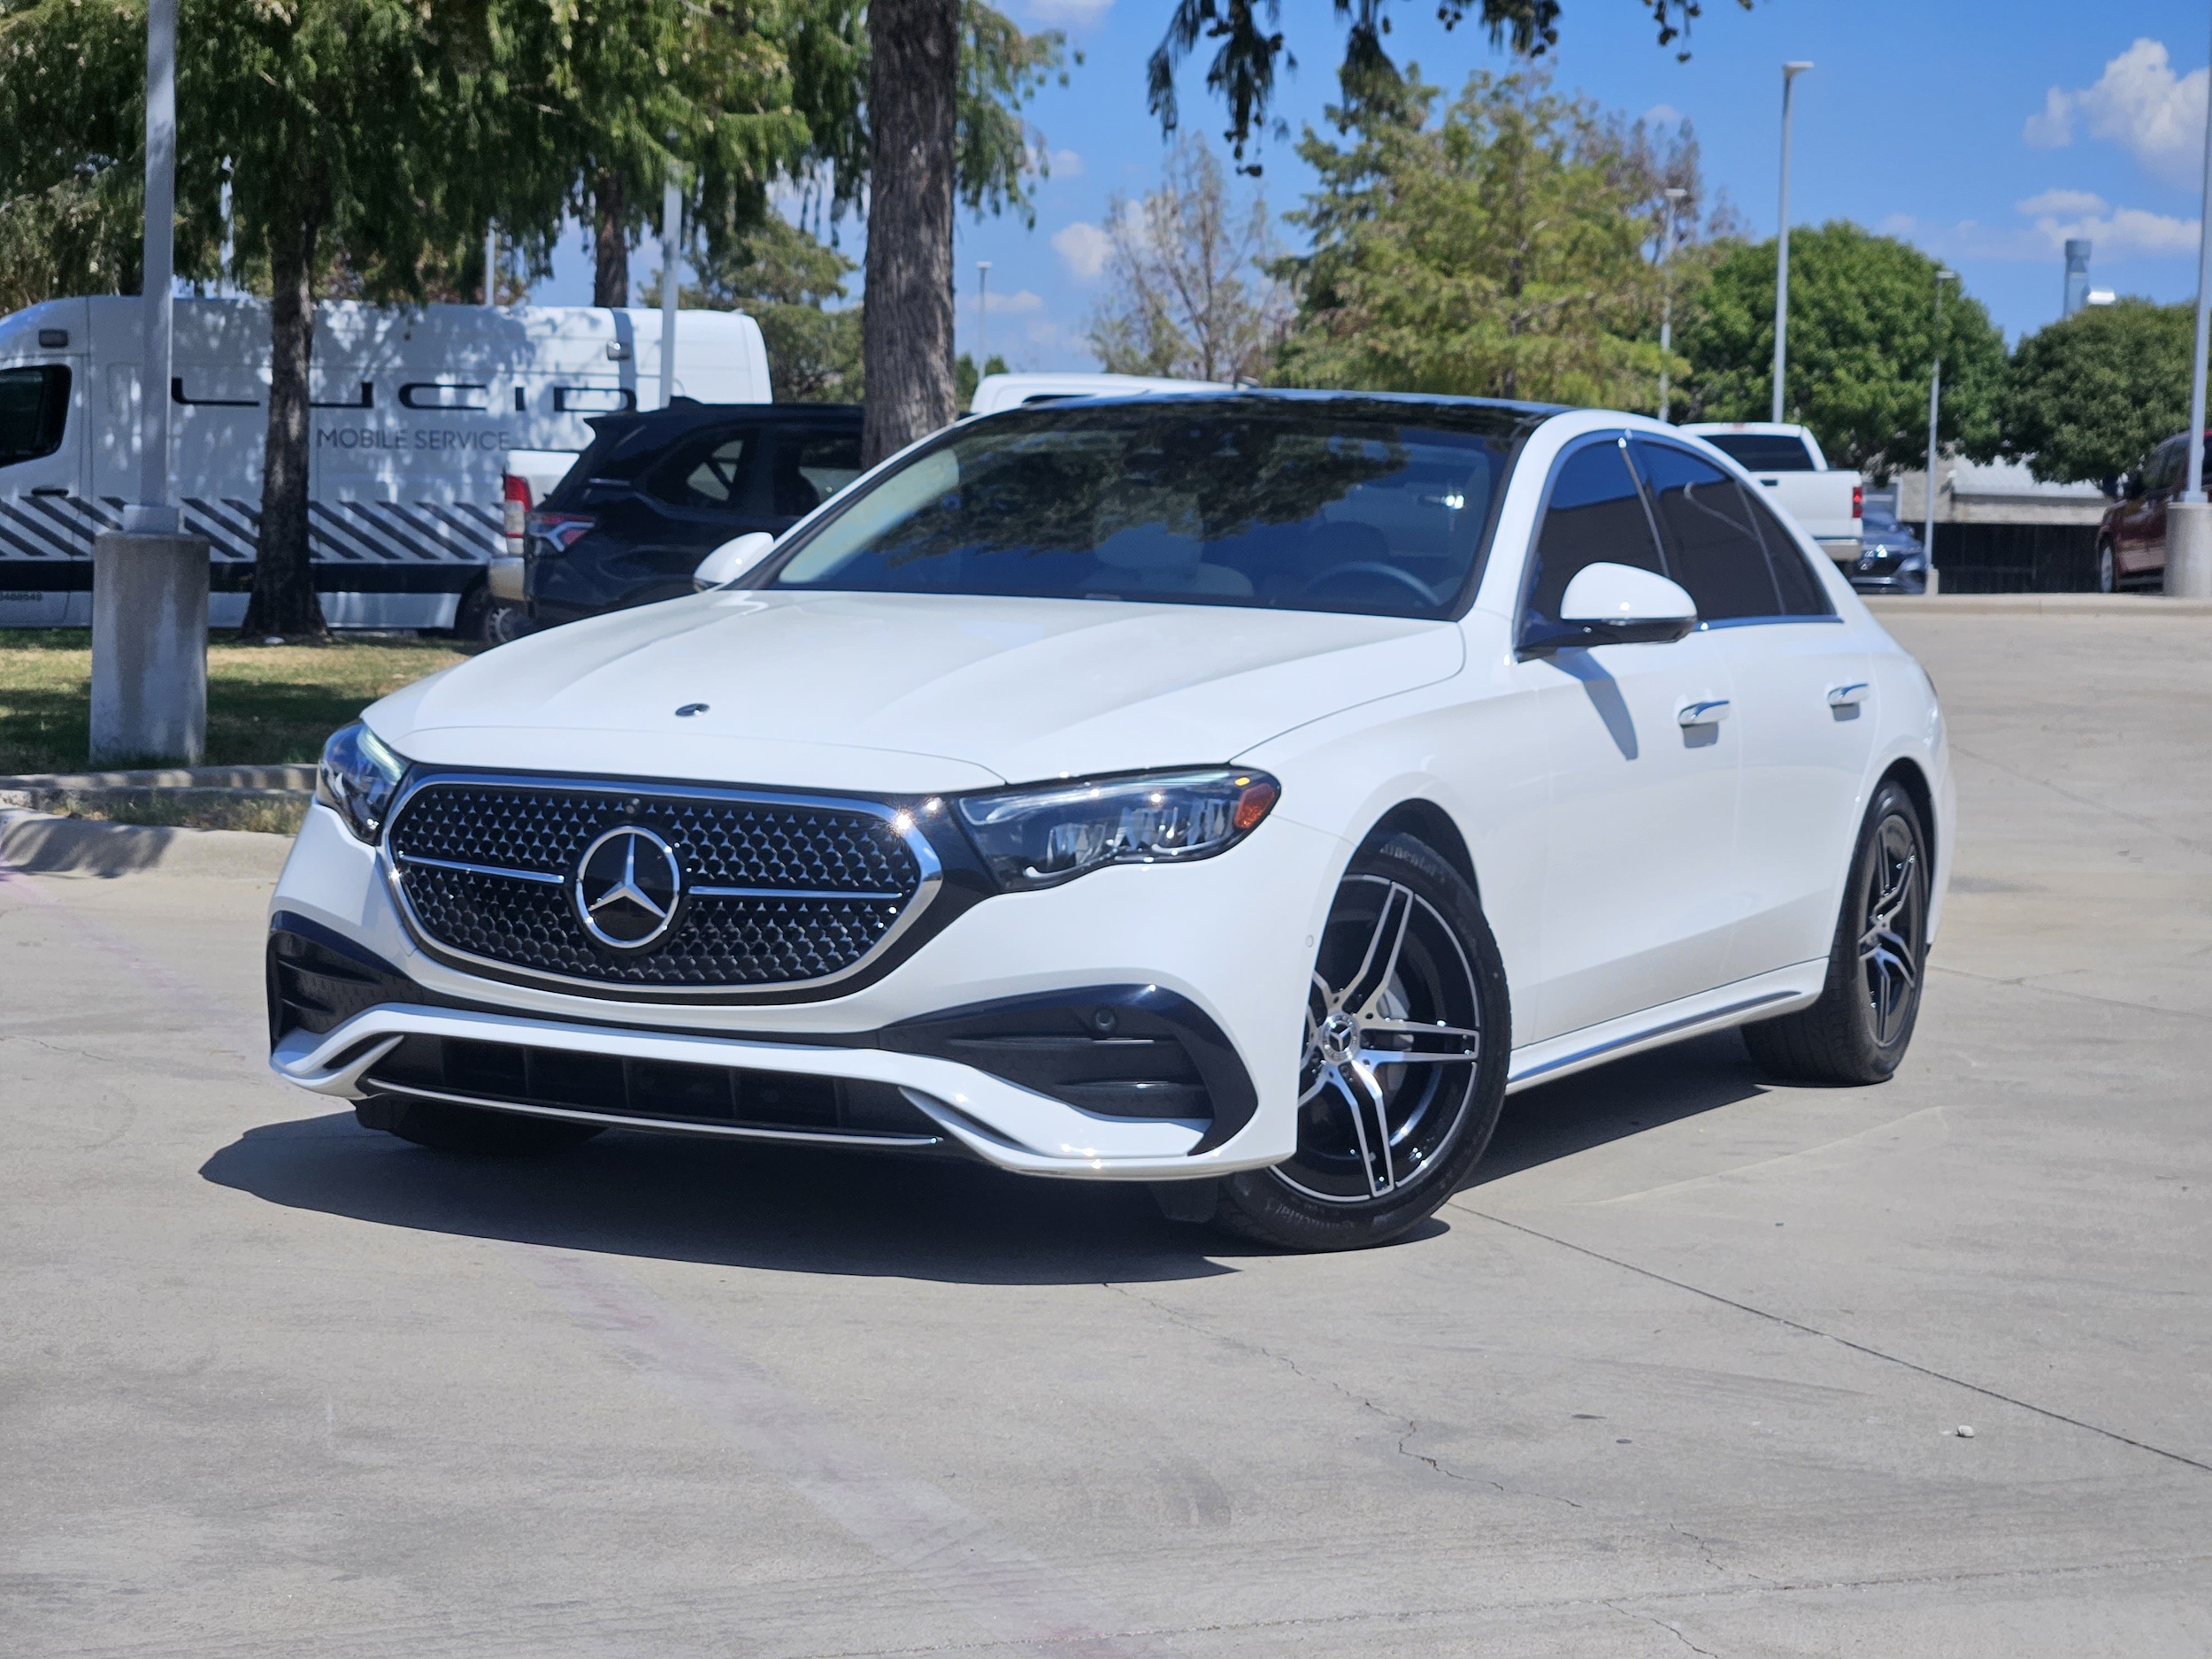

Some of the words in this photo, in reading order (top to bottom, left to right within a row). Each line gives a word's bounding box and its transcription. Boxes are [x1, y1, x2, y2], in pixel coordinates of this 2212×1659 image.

[171, 376, 637, 412] LUCID
[316, 427, 410, 449] MOBILE
[414, 429, 511, 451] SERVICE
